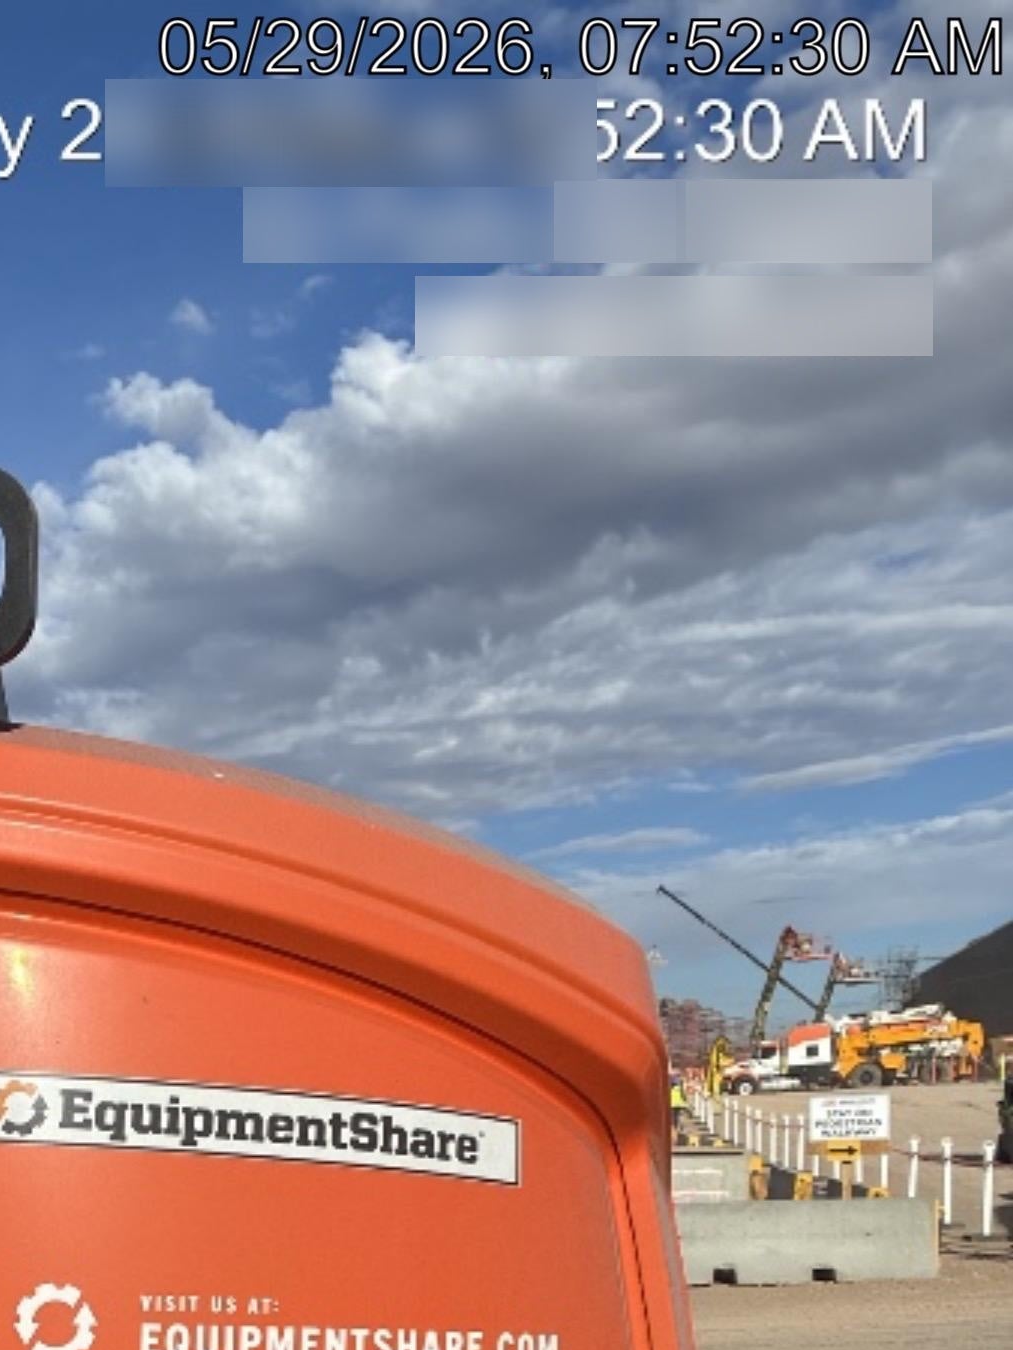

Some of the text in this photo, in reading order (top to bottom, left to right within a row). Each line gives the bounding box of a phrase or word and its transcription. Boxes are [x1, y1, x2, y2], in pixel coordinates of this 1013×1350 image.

[59, 1088, 480, 1164] EquipmentShare
[140, 1295, 279, 1315] VISIT US AT:
